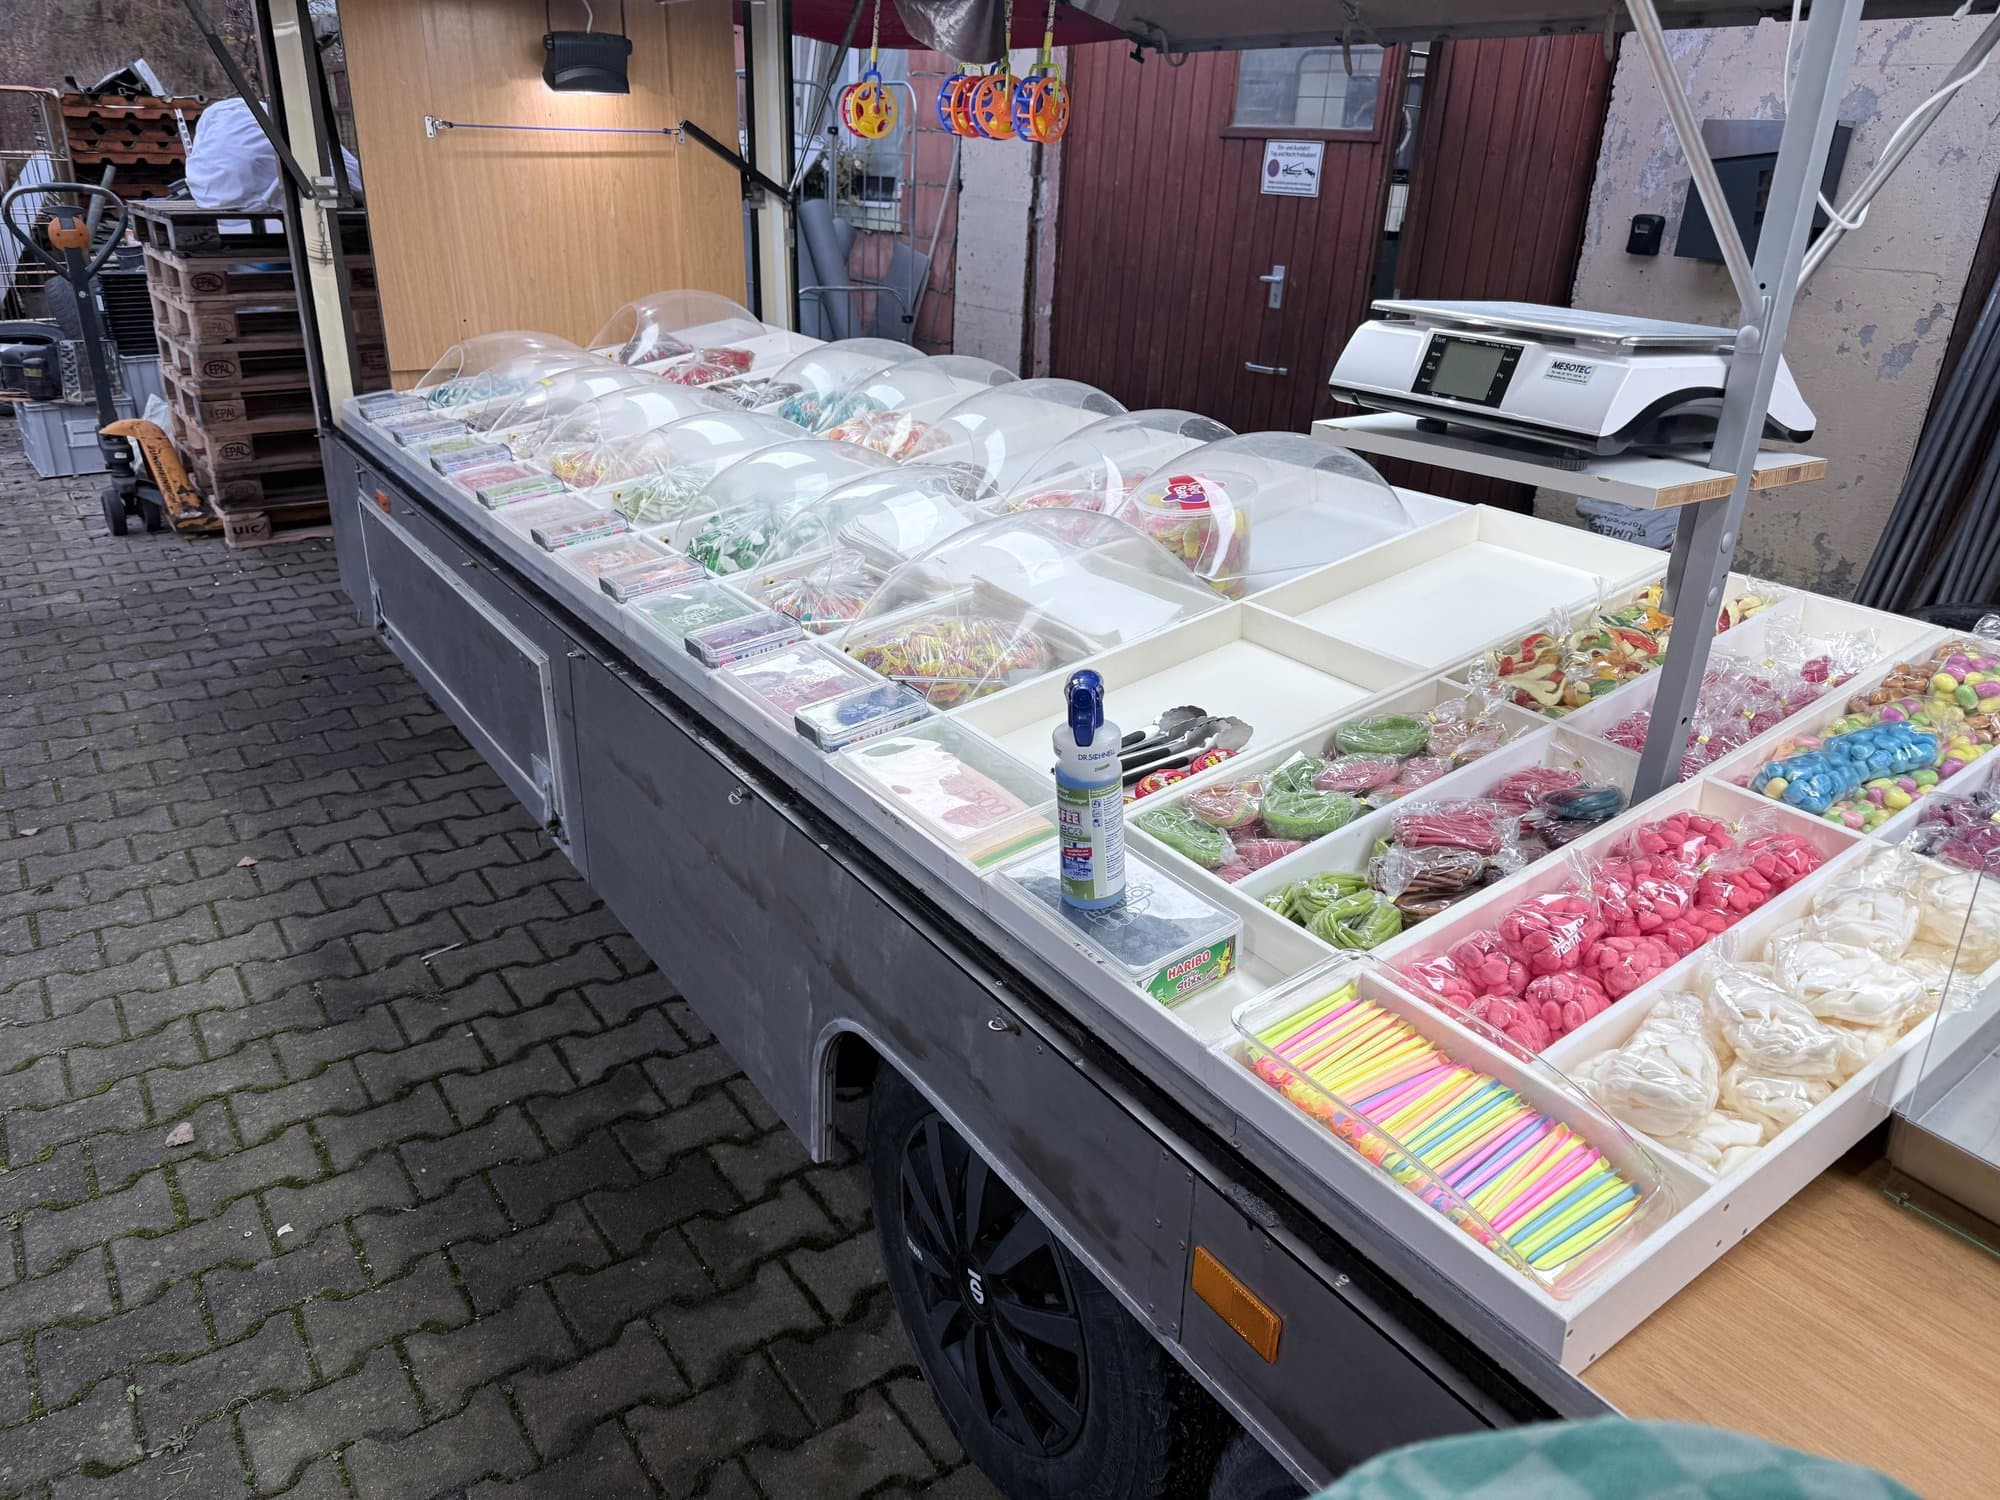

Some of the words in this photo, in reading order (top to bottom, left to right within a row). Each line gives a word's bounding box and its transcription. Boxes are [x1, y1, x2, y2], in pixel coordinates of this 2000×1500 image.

[208, 363, 231, 375] EPAL
[1552, 361, 1592, 374] MESOTEC
[215, 407, 237, 418] EPAL
[224, 445, 246, 457] EPAL
[1167, 950, 1211, 981] HARIBO
